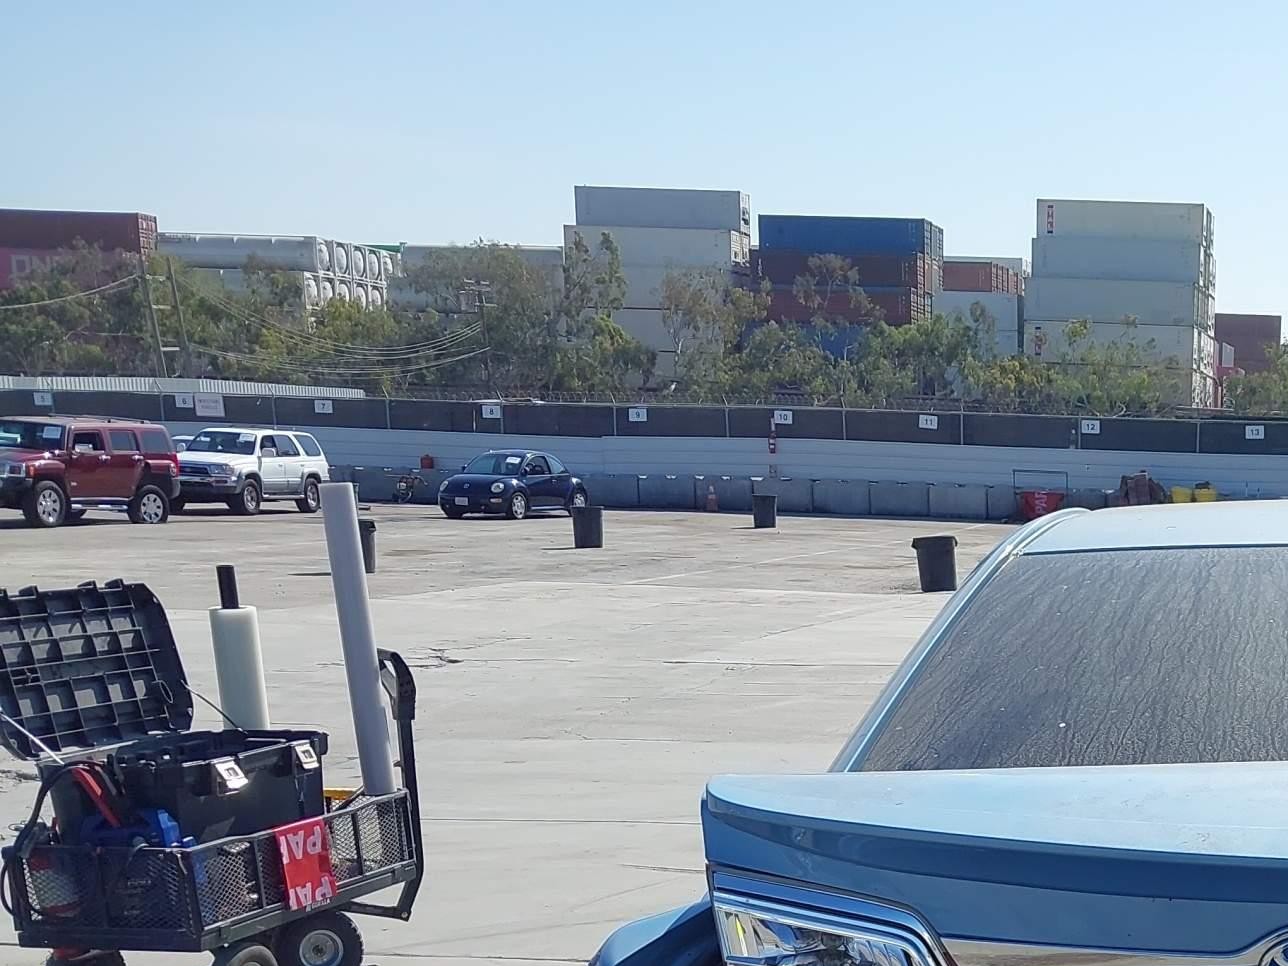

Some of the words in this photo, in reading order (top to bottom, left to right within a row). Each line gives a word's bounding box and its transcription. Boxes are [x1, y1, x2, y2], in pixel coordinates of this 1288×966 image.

[779, 413, 788, 421] 10
[925, 418, 933, 426] 11
[1086, 423, 1096, 431] 12
